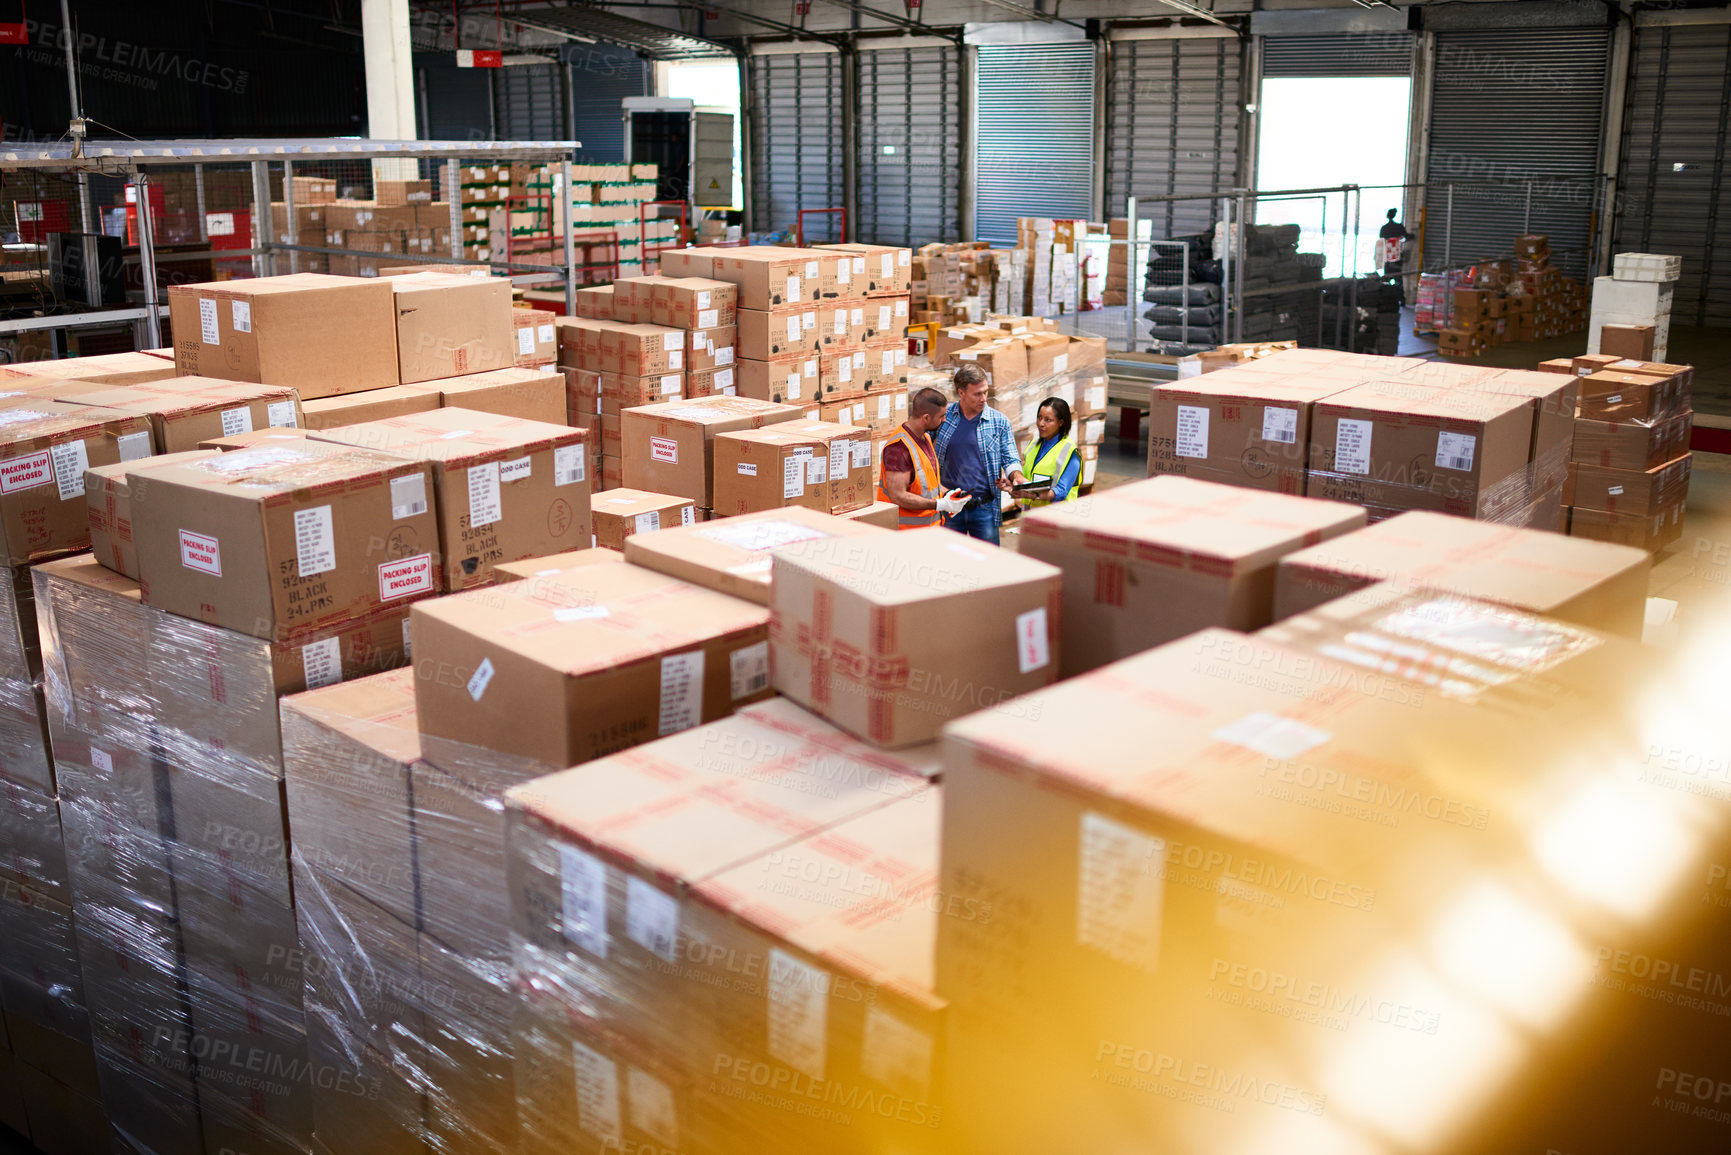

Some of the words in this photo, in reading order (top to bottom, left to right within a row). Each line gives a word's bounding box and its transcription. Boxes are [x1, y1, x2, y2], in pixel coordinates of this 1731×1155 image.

[1, 462, 31, 476] PACKING
[33, 458, 47, 468] SLIP
[500, 463, 513, 474] ODD
[514, 461, 530, 470] CASE
[9, 470, 43, 484] ENCLOSED
[182, 538, 204, 551] PACKING
[204, 544, 217, 554] SLIP
[466, 536, 498, 556] BLACK
[188, 552, 215, 565] ENCLOSED
[384, 566, 412, 580] PACKING
[414, 564, 427, 573] SLIP
[390, 576, 422, 590] ENCLOSED
[288, 581, 328, 604] BLACK
